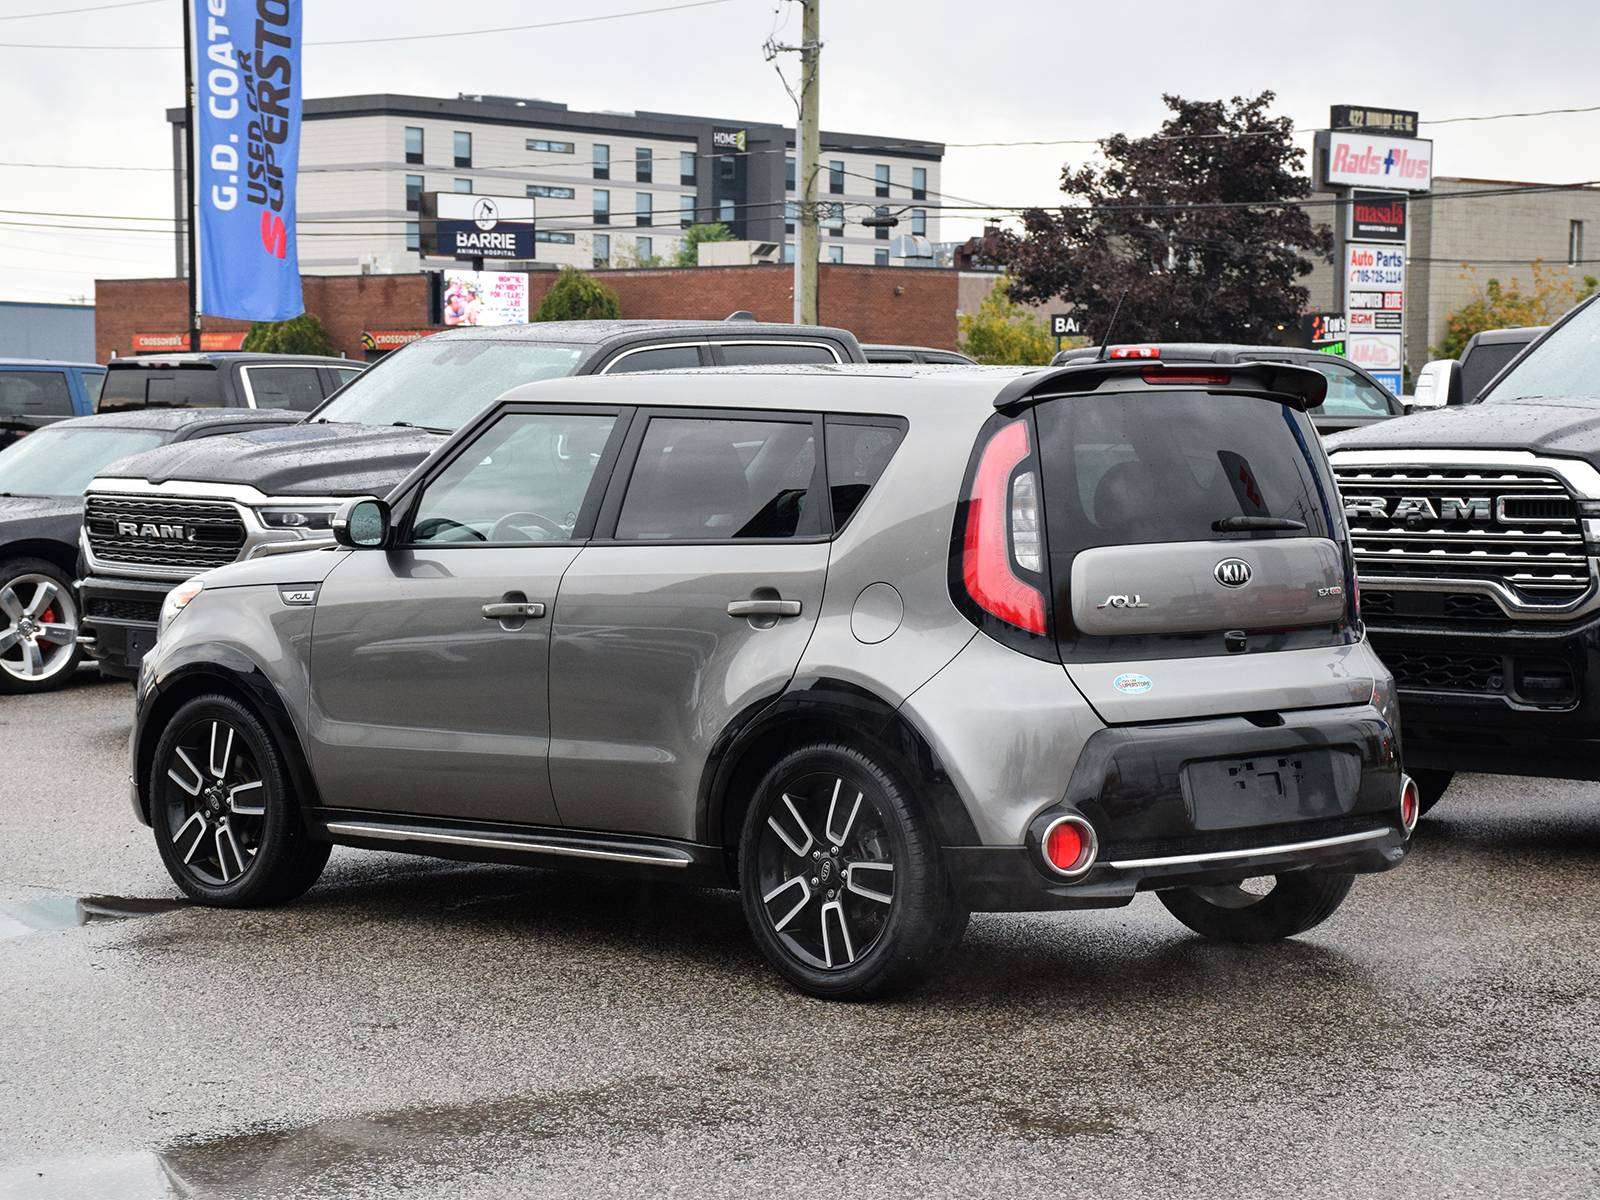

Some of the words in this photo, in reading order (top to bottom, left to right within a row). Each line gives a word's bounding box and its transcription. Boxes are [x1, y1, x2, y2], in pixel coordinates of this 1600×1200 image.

[236, 49, 260, 113] CAR
[247, 124, 269, 205] USED
[1332, 143, 1382, 176] Rads
[210, 134, 239, 211] G.D.
[456, 232, 516, 249] BARRIE
[1351, 250, 1374, 266] Auto
[1376, 251, 1402, 267] Parts
[1351, 313, 1372, 324] EGM
[1343, 496, 1491, 520] RAM
[118, 522, 184, 539] RAM
[1221, 564, 1249, 583] KIA
